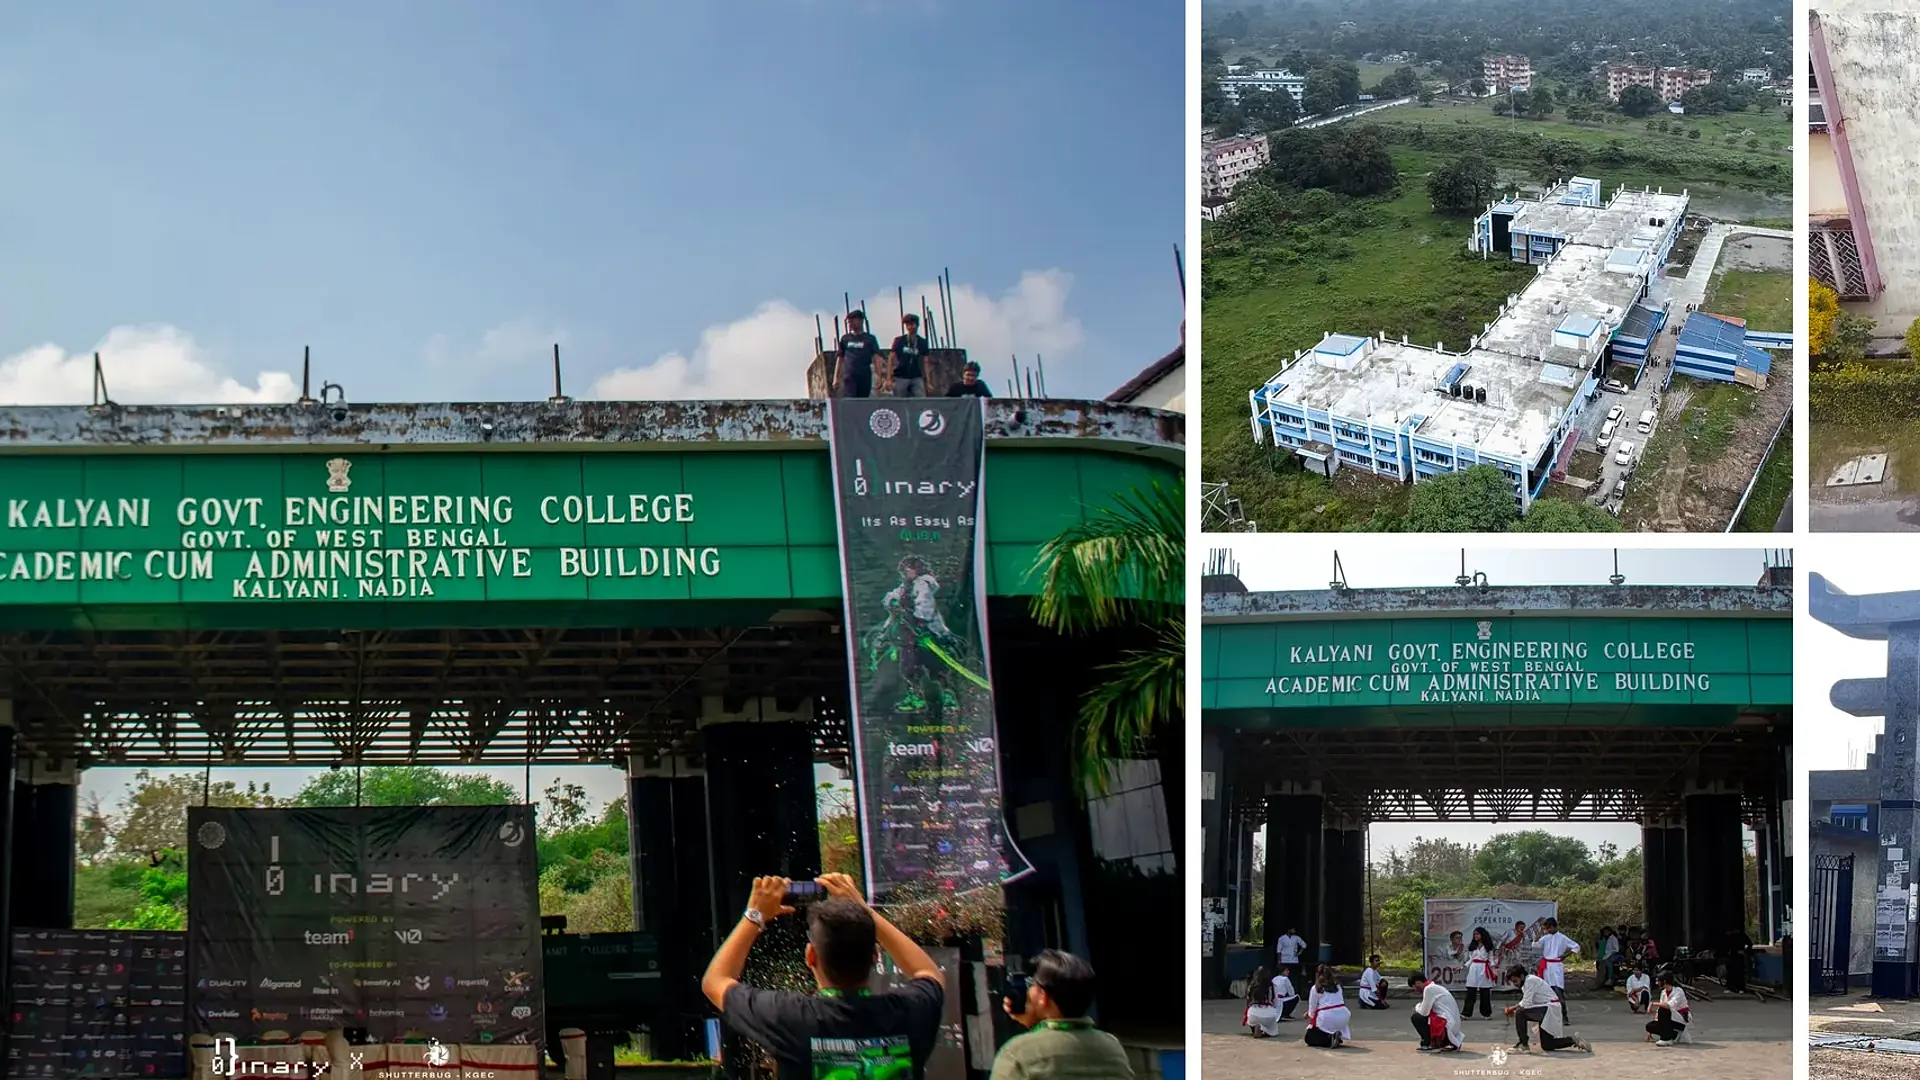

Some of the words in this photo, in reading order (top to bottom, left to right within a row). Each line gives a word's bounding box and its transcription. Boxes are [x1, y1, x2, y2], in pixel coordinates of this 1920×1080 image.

[8, 497, 151, 528] KALYANI
[177, 496, 267, 529] GOVT.
[286, 495, 514, 526] ENGINEERING
[540, 494, 694, 524] COLLEGE
[915, 516, 950, 528] Easy
[182, 530, 251, 549] GOVT.
[266, 530, 297, 549] OF
[316, 530, 384, 548] WEST
[407, 528, 507, 548] BENGAL
[0, 551, 133, 582] ADEMIC
[144, 550, 214, 580] CUM
[245, 548, 532, 579] ADMINISTRATIVE
[560, 547, 721, 577] BUILDING
[358, 578, 435, 599] NADIA
[1290, 644, 1373, 663] KALYANI
[1389, 643, 1441, 662] GOVT.
[1452, 641, 1588, 661] ENGINEERING
[1604, 642, 1695, 660] COLLEGE
[1441, 662, 1460, 673] OF
[1471, 662, 1511, 673] WEST
[1525, 661, 1584, 672] BENGAL
[1265, 676, 1362, 694] ACADEMIC
[1369, 674, 1410, 692] CUM
[1428, 673, 1598, 691] ADMINISTRATIVE
[1615, 673, 1710, 691] BUILDING
[1495, 690, 1540, 701] NADIA
[259, 976, 302, 990] Algorand
